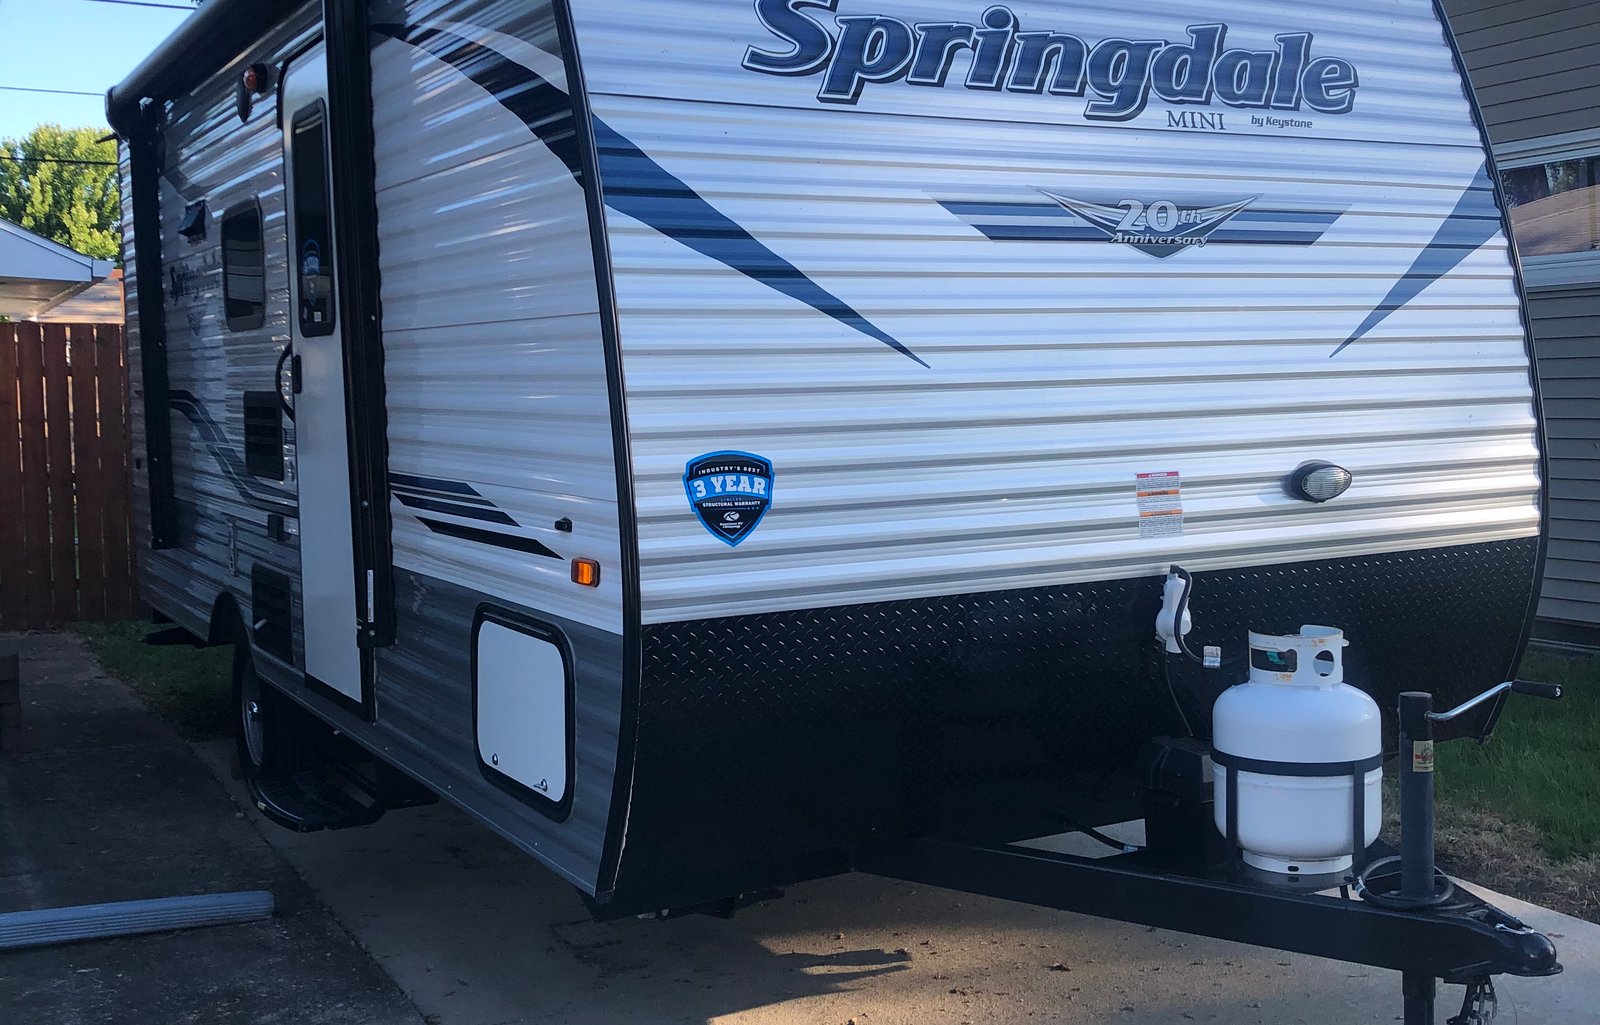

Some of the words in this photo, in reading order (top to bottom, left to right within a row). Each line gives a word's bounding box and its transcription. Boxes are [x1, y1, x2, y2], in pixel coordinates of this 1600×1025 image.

[741, 0, 1358, 121] Springdale
[1166, 109, 1227, 130] MINI
[1251, 115, 1264, 127] by
[1265, 116, 1313, 129] Keystone
[1115, 198, 1202, 232] 20th
[1109, 232, 1209, 247] Anniversary
[698, 466, 741, 475] INDUSTRY'S
[743, 466, 760, 474] BEST
[693, 479, 707, 498] 3
[710, 475, 766, 495] YEAR
